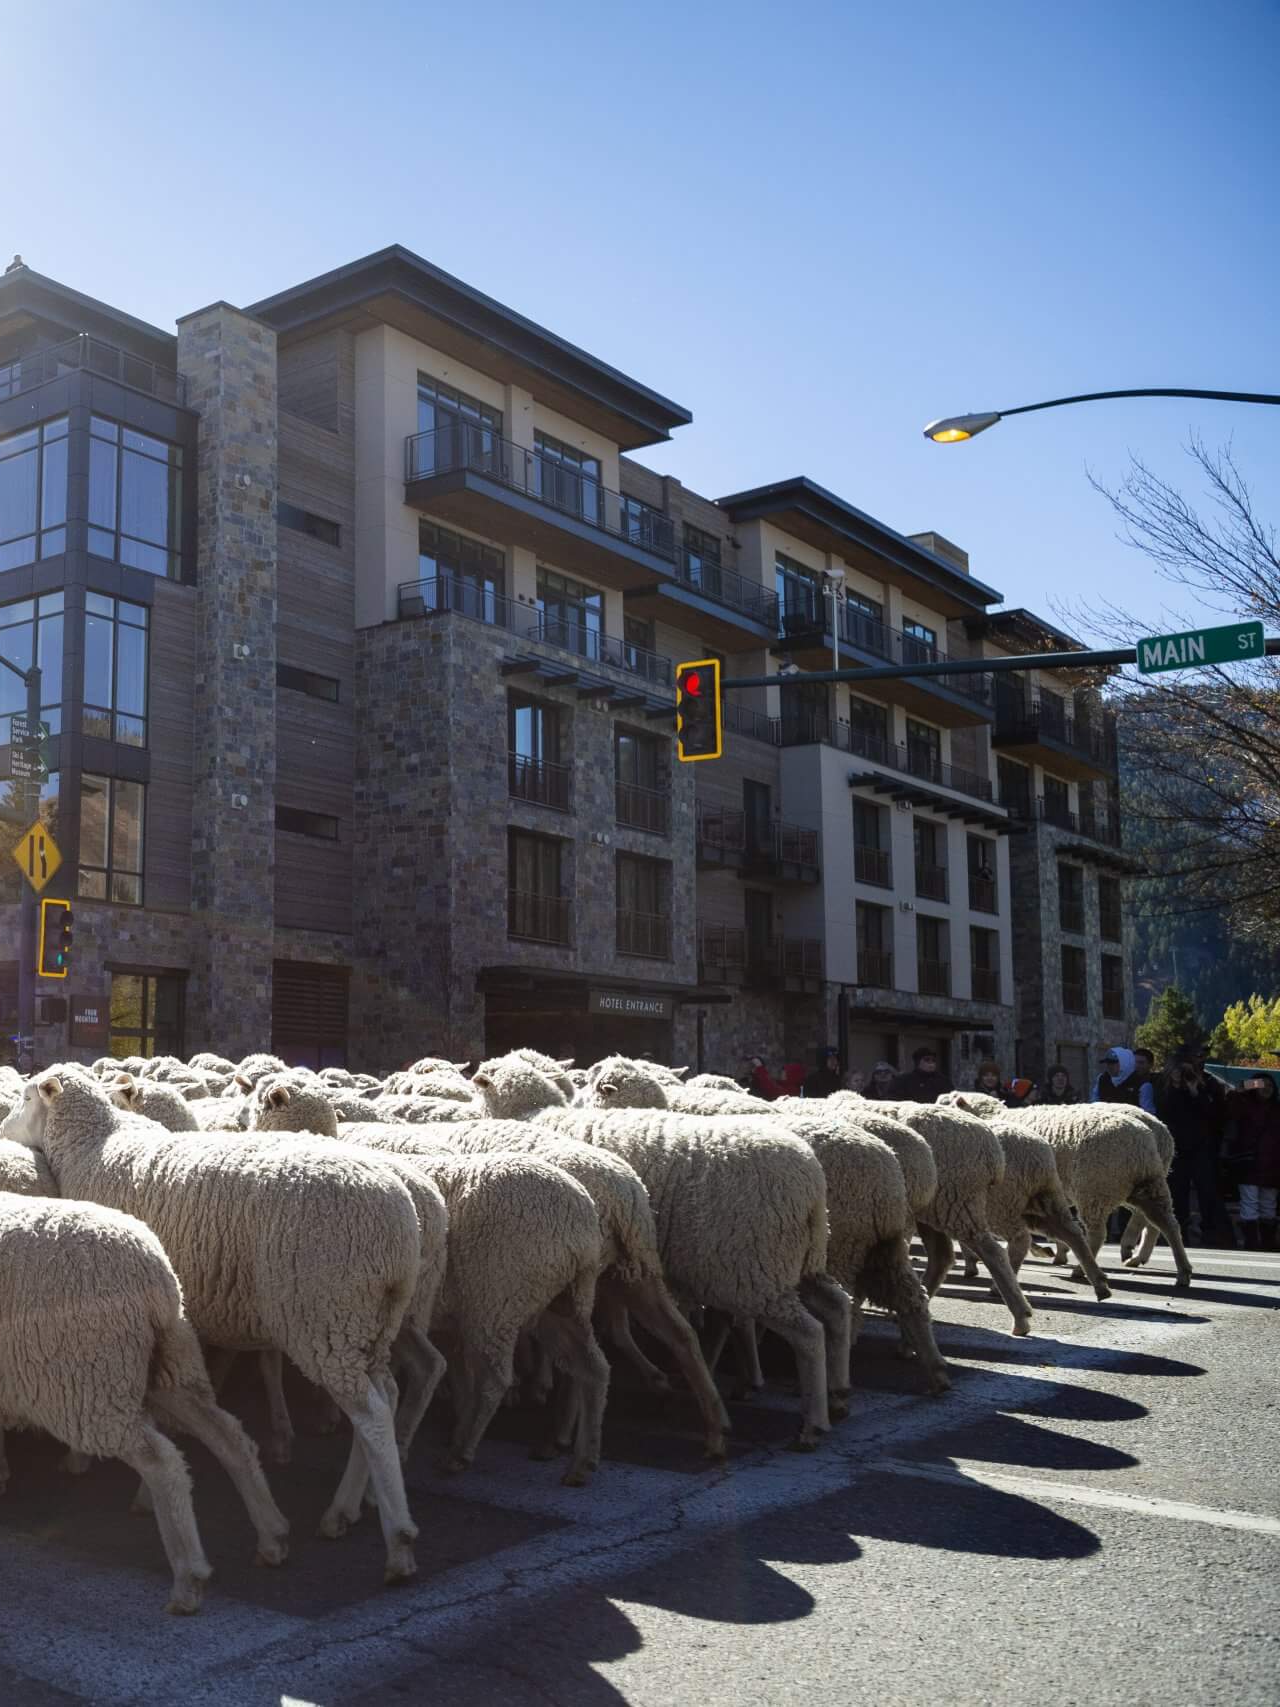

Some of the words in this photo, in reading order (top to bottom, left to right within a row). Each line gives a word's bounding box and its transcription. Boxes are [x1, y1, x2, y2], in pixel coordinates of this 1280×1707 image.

[1143, 635, 1206, 669] MAIN
[1237, 632, 1257, 650] ST
[12, 718, 27, 728] Forest
[12, 727, 30, 737] Service
[599, 995, 623, 1010] HOTEL
[626, 1000, 664, 1014] ENTRANCE
